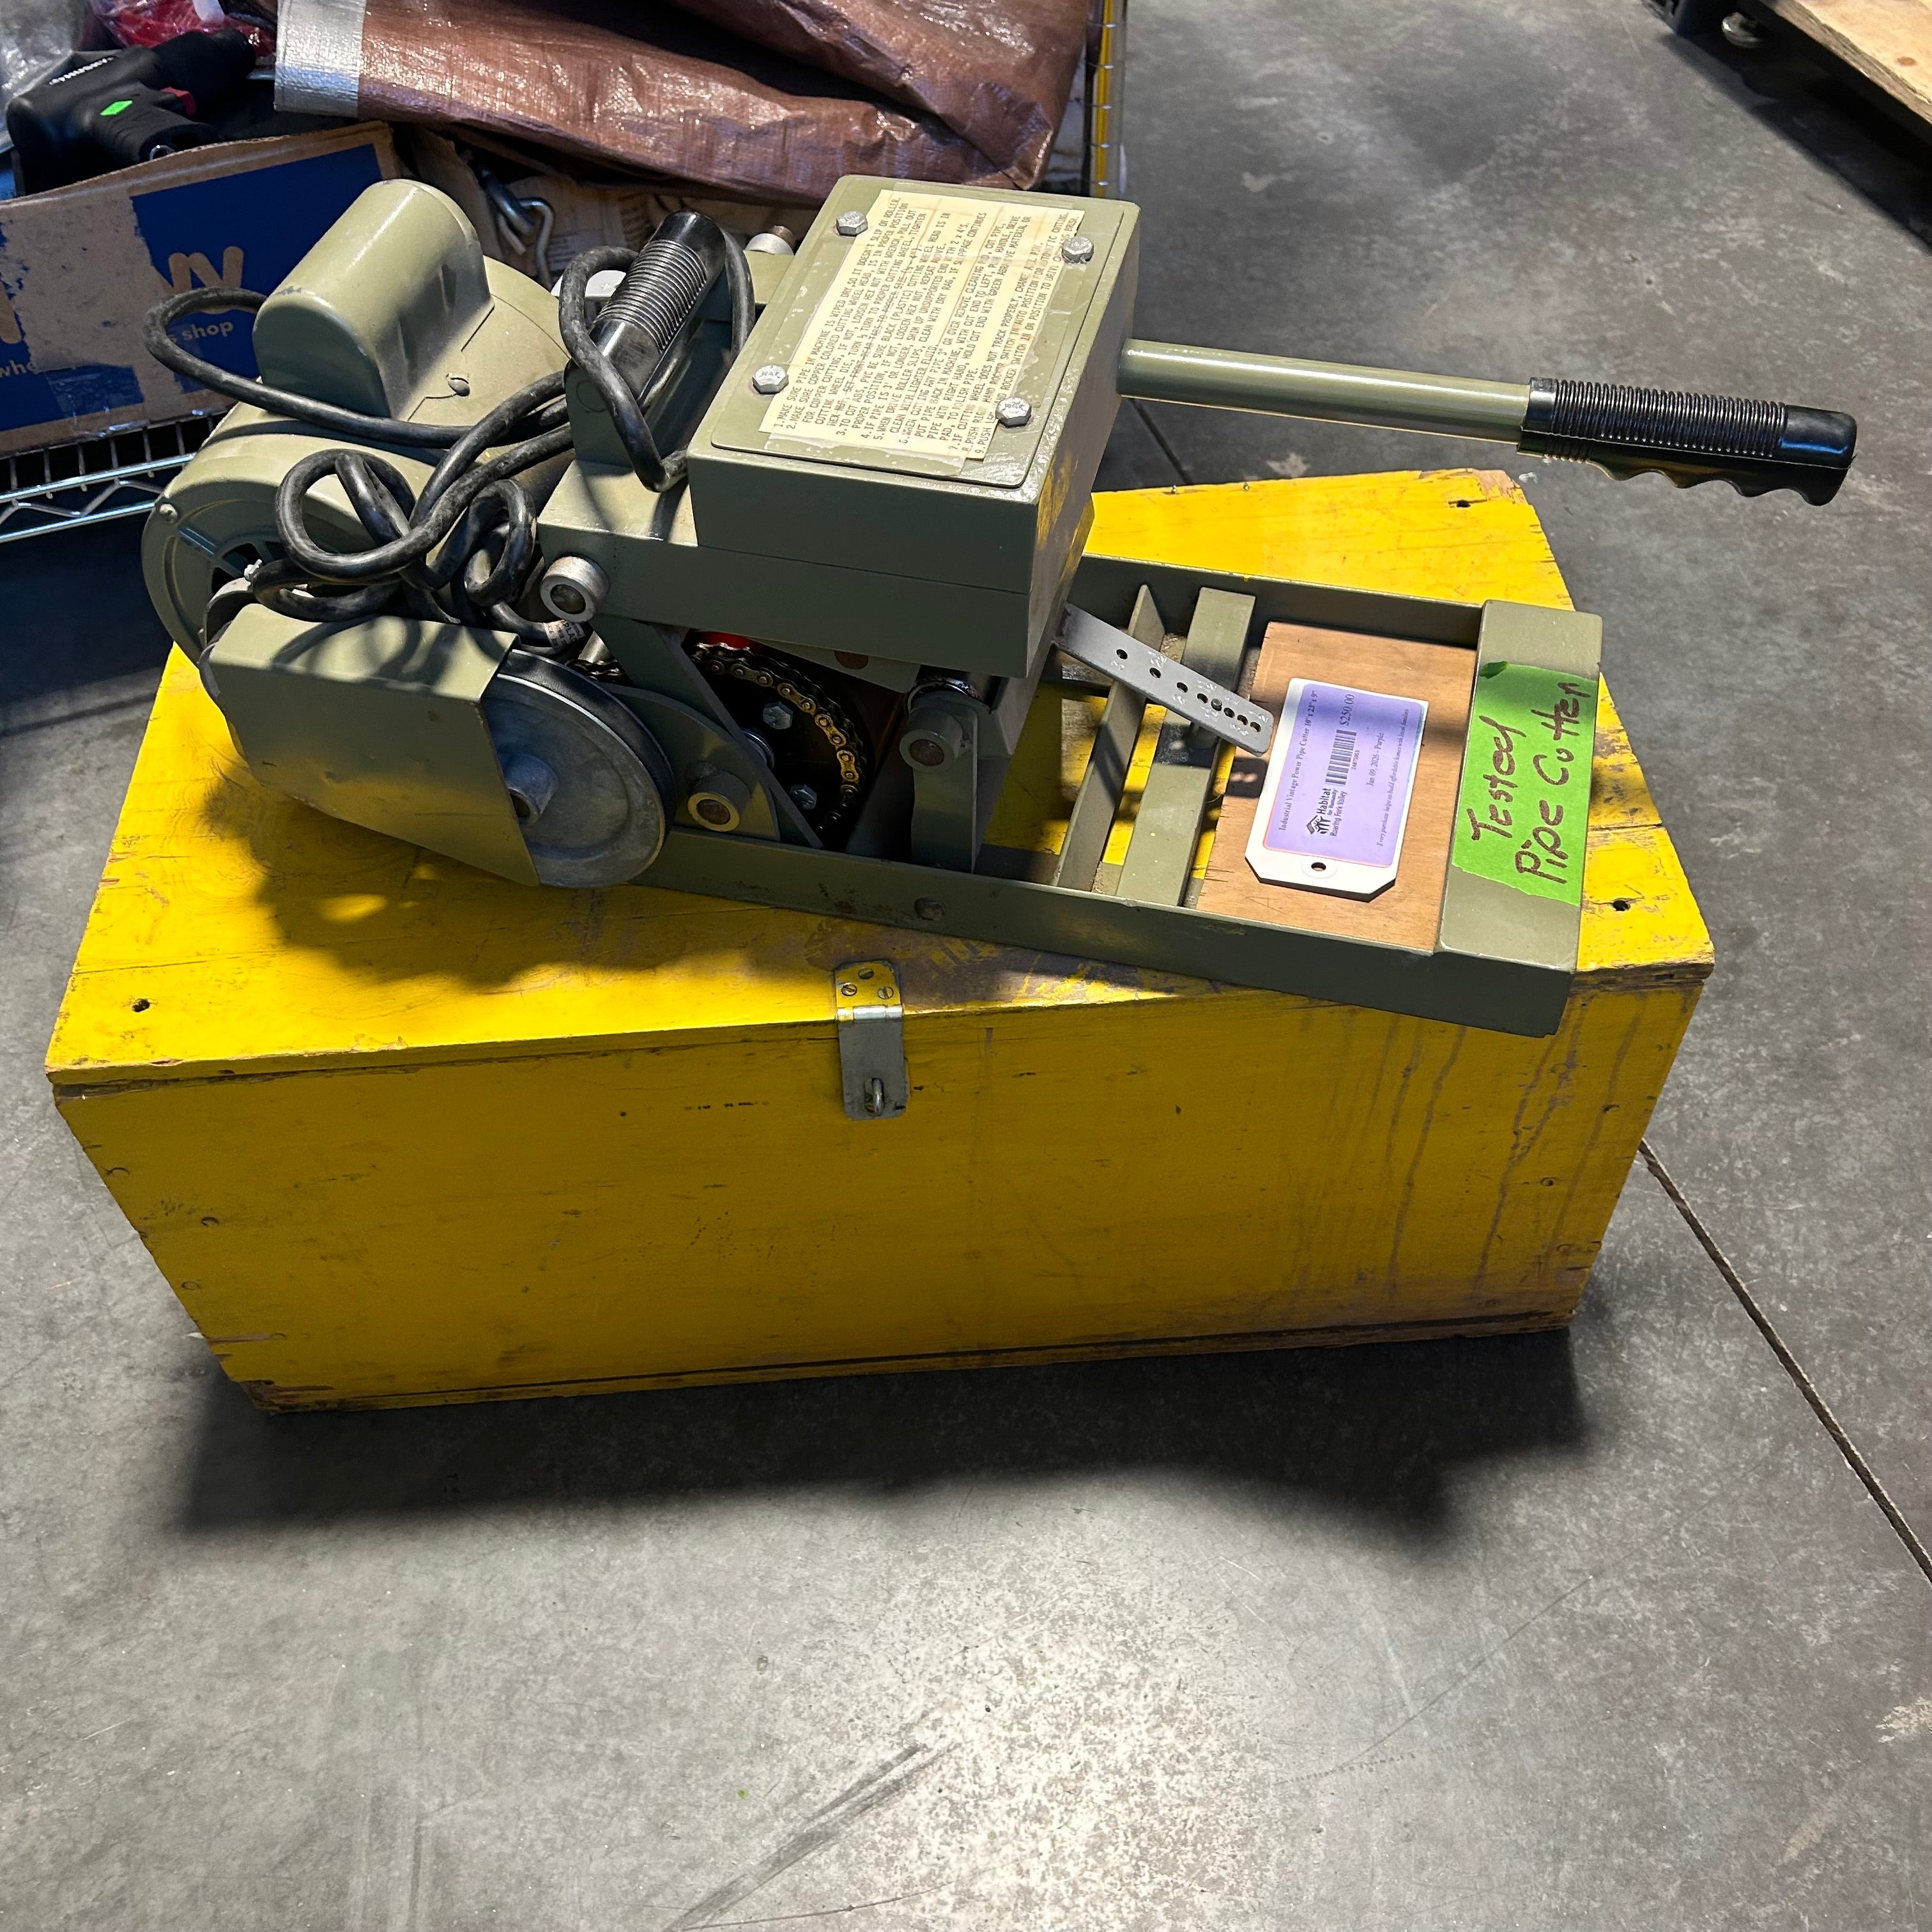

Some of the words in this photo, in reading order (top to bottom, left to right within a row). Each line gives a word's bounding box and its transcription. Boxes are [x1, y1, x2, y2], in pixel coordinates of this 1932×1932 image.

[904, 209, 917, 220] OUT
[984, 239, 997, 249] CUT
[875, 260, 890, 274] WITH
[907, 264, 925, 287] CUTTING
[937, 263, 949, 273] END
[869, 277, 882, 287] NUT
[964, 266, 984, 293] CLEANING
[988, 278, 1003, 296] GREEN
[862, 289, 876, 300] HEX
[918, 275, 944, 313] UNSUPPORTED
[1020, 280, 1040, 307] POSITION
[850, 302, 870, 323] LOOSEN
[953, 295, 971, 318] REMOVE
[980, 298, 995, 313] WITH
[786, 386, 802, 401] SURE
[795, 367, 811, 383] PIPE
[809, 330, 831, 355] MACHINE
[829, 300, 846, 317] WIPED
[869, 229, 884, 241] SLIP
[913, 316, 925, 324] UP
[974, 316, 987, 327] END
[1013, 310, 1028, 325] AUTO
[181, 321, 234, 340] shop
[828, 375, 846, 395] WHEEL
[847, 341, 862, 356] TURN
[859, 317, 875, 331] TURN
[872, 284, 891, 304] PROPER
[884, 259, 903, 282] CUTTING
[880, 323, 897, 341] BLACK
[946, 320, 961, 335] OVER
[969, 330, 981, 341] CUT
[798, 387, 814, 402] SURE
[808, 362, 826, 384] COPPER
[820, 334, 840, 360] COLORED
[834, 307, 854, 332] CUTTING
[847, 288, 864, 305] WHEEL
[991, 329, 1007, 347] TRACK
[999, 367, 1017, 390] ROCKER
[1009, 343, 1027, 364] SWITCH
[1028, 292, 1047, 320] POSITION
[851, 406, 870, 429] PROPER
[894, 318, 912, 339] LOOSEN
[905, 304, 918, 315] HEX
[919, 265, 936, 285] REPEAT
[871, 344, 887, 358] SURE
[884, 393, 903, 413] DRIVE
[895, 369, 914, 390] ROLLER
[917, 324, 933, 342] CLEAN
[926, 307, 942, 321] WITH
[935, 293, 947, 303] DRY
[961, 343, 976, 359] HOLD
[999, 337, 1016, 360] SWITCH
[866, 360, 878, 369] BE
[985, 351, 998, 362] NOT
[887, 370, 900, 378] OR
[914, 424, 928, 436] PUT
[921, 405, 937, 421] PIPE
[954, 328, 969, 344] WITH
[962, 314, 976, 326] CUT
[969, 300, 981, 312] END
[929, 358, 944, 373] PIPE
[977, 364, 992, 379] DOES
[860, 371, 874, 383] PVC
[809, 385, 828, 408] COPPER
[877, 391, 890, 400] IS
[889, 413, 906, 433] CLEAN
[907, 367, 928, 392] LIGHTER
[943, 382, 959, 401] RIGHT
[969, 382, 985, 401] WHEEL
[981, 387, 997, 402] HAND
[801, 410, 816, 422] FOR
[844, 404, 858, 416] CUT
[869, 404, 884, 419] PIPE
[947, 411, 960, 420] TO
[926, 422, 942, 439] PIPE
[1338, 693, 1355, 726] $250.00
[1530, 682, 1592, 786] Cutter
[1466, 714, 1527, 841] Tested
[1316, 787, 1331, 814] Habitat
[1278, 802, 1292, 830] Industrial
[1333, 805, 1343, 816] Fork
[1514, 799, 1569, 884] Pipe
